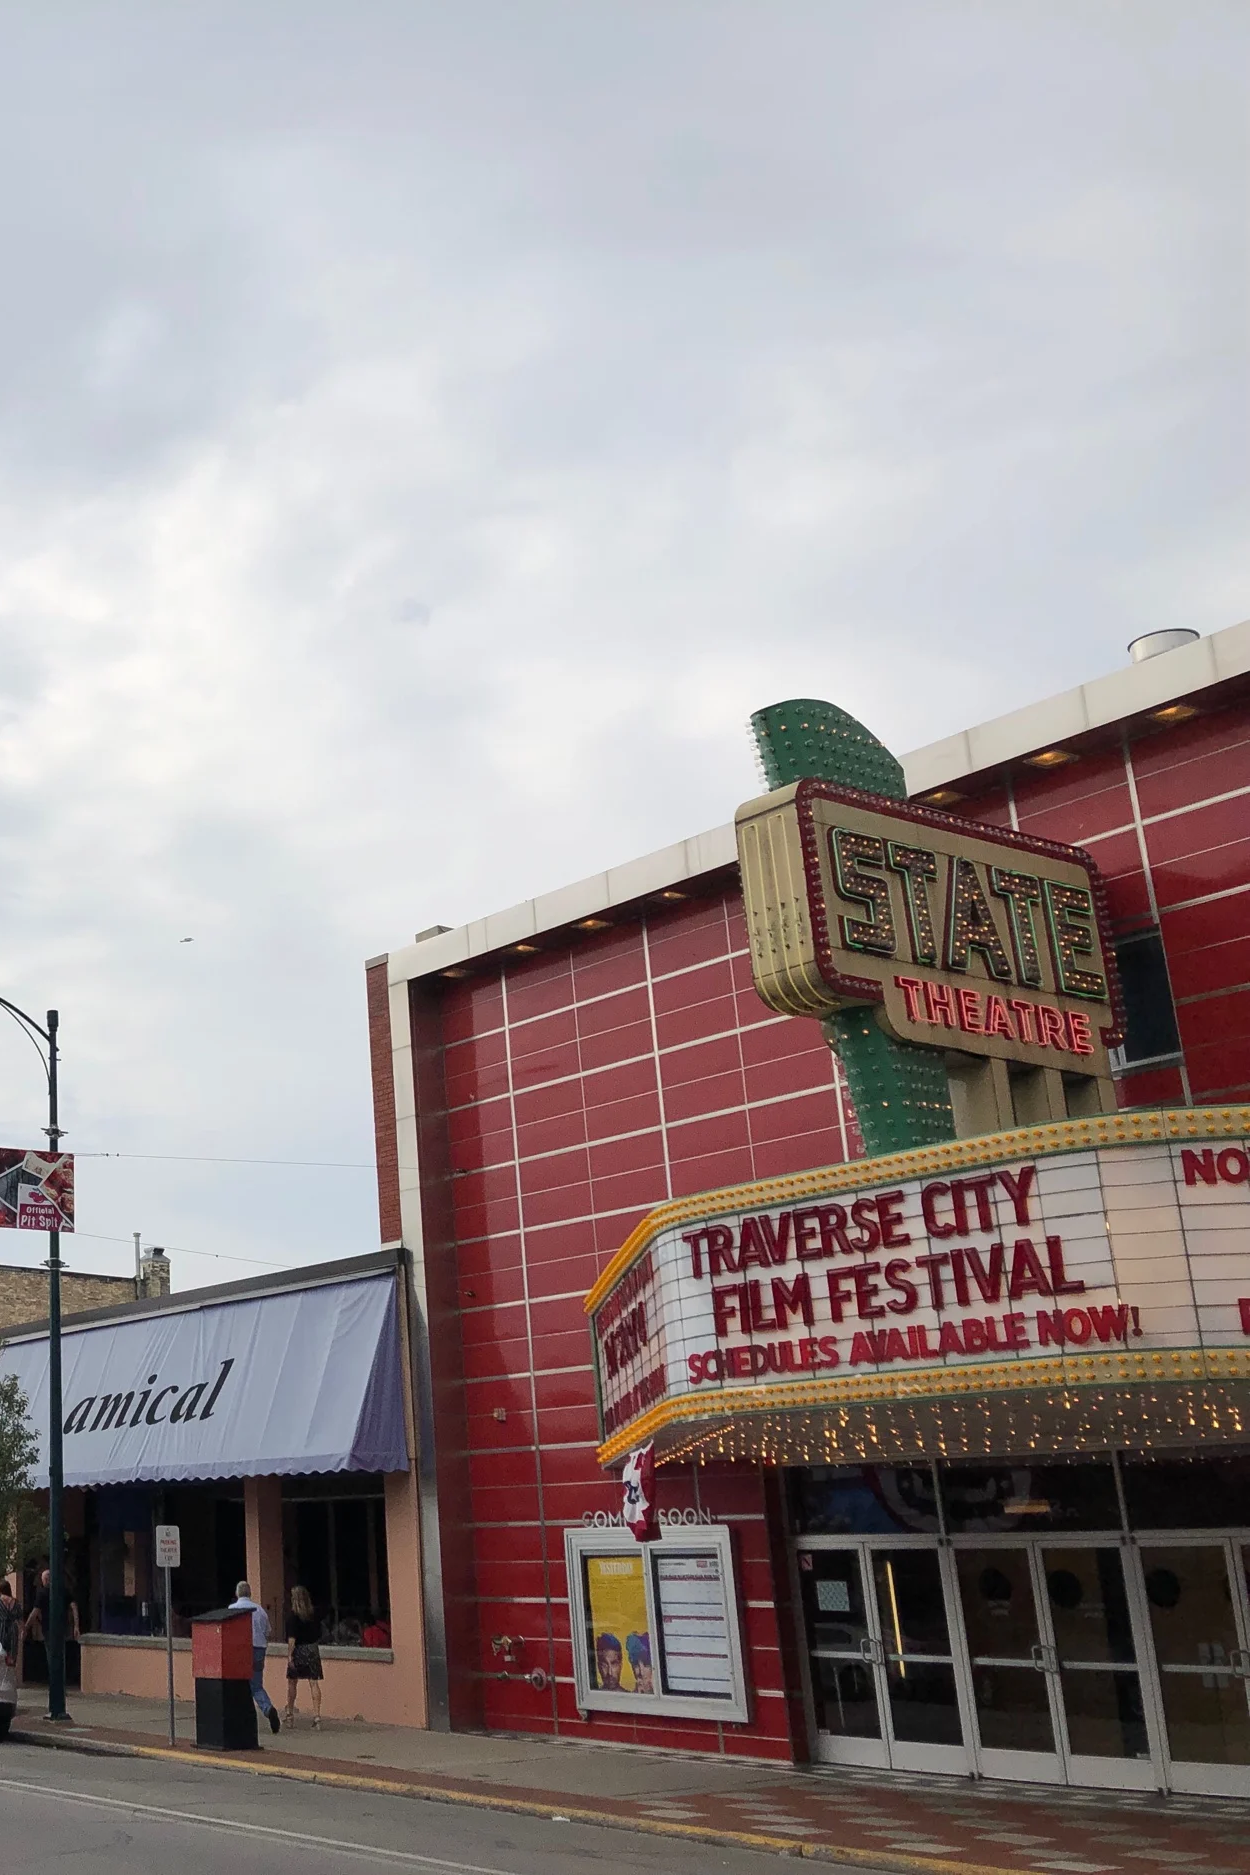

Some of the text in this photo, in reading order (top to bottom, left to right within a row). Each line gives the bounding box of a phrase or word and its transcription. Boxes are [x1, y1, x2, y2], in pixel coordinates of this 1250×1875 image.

[828, 826, 1108, 999] STATE
[894, 975, 1096, 1056] THEATRE
[1180, 1147, 1250, 1186] NO
[20, 1214, 58, 1230] Pit Spit
[26, 1206, 55, 1215] Official
[681, 1164, 1037, 1279] TRAVERSE CITY
[710, 1271, 816, 1338] FILM
[826, 1234, 1086, 1323] FESTIVAL
[688, 1336, 840, 1386] SCHEDULES
[849, 1310, 1032, 1366] AVAILABLE
[1037, 1302, 1144, 1348] NOW!
[62, 1357, 236, 1437] amical
[658, 1507, 712, 1526] SOON
